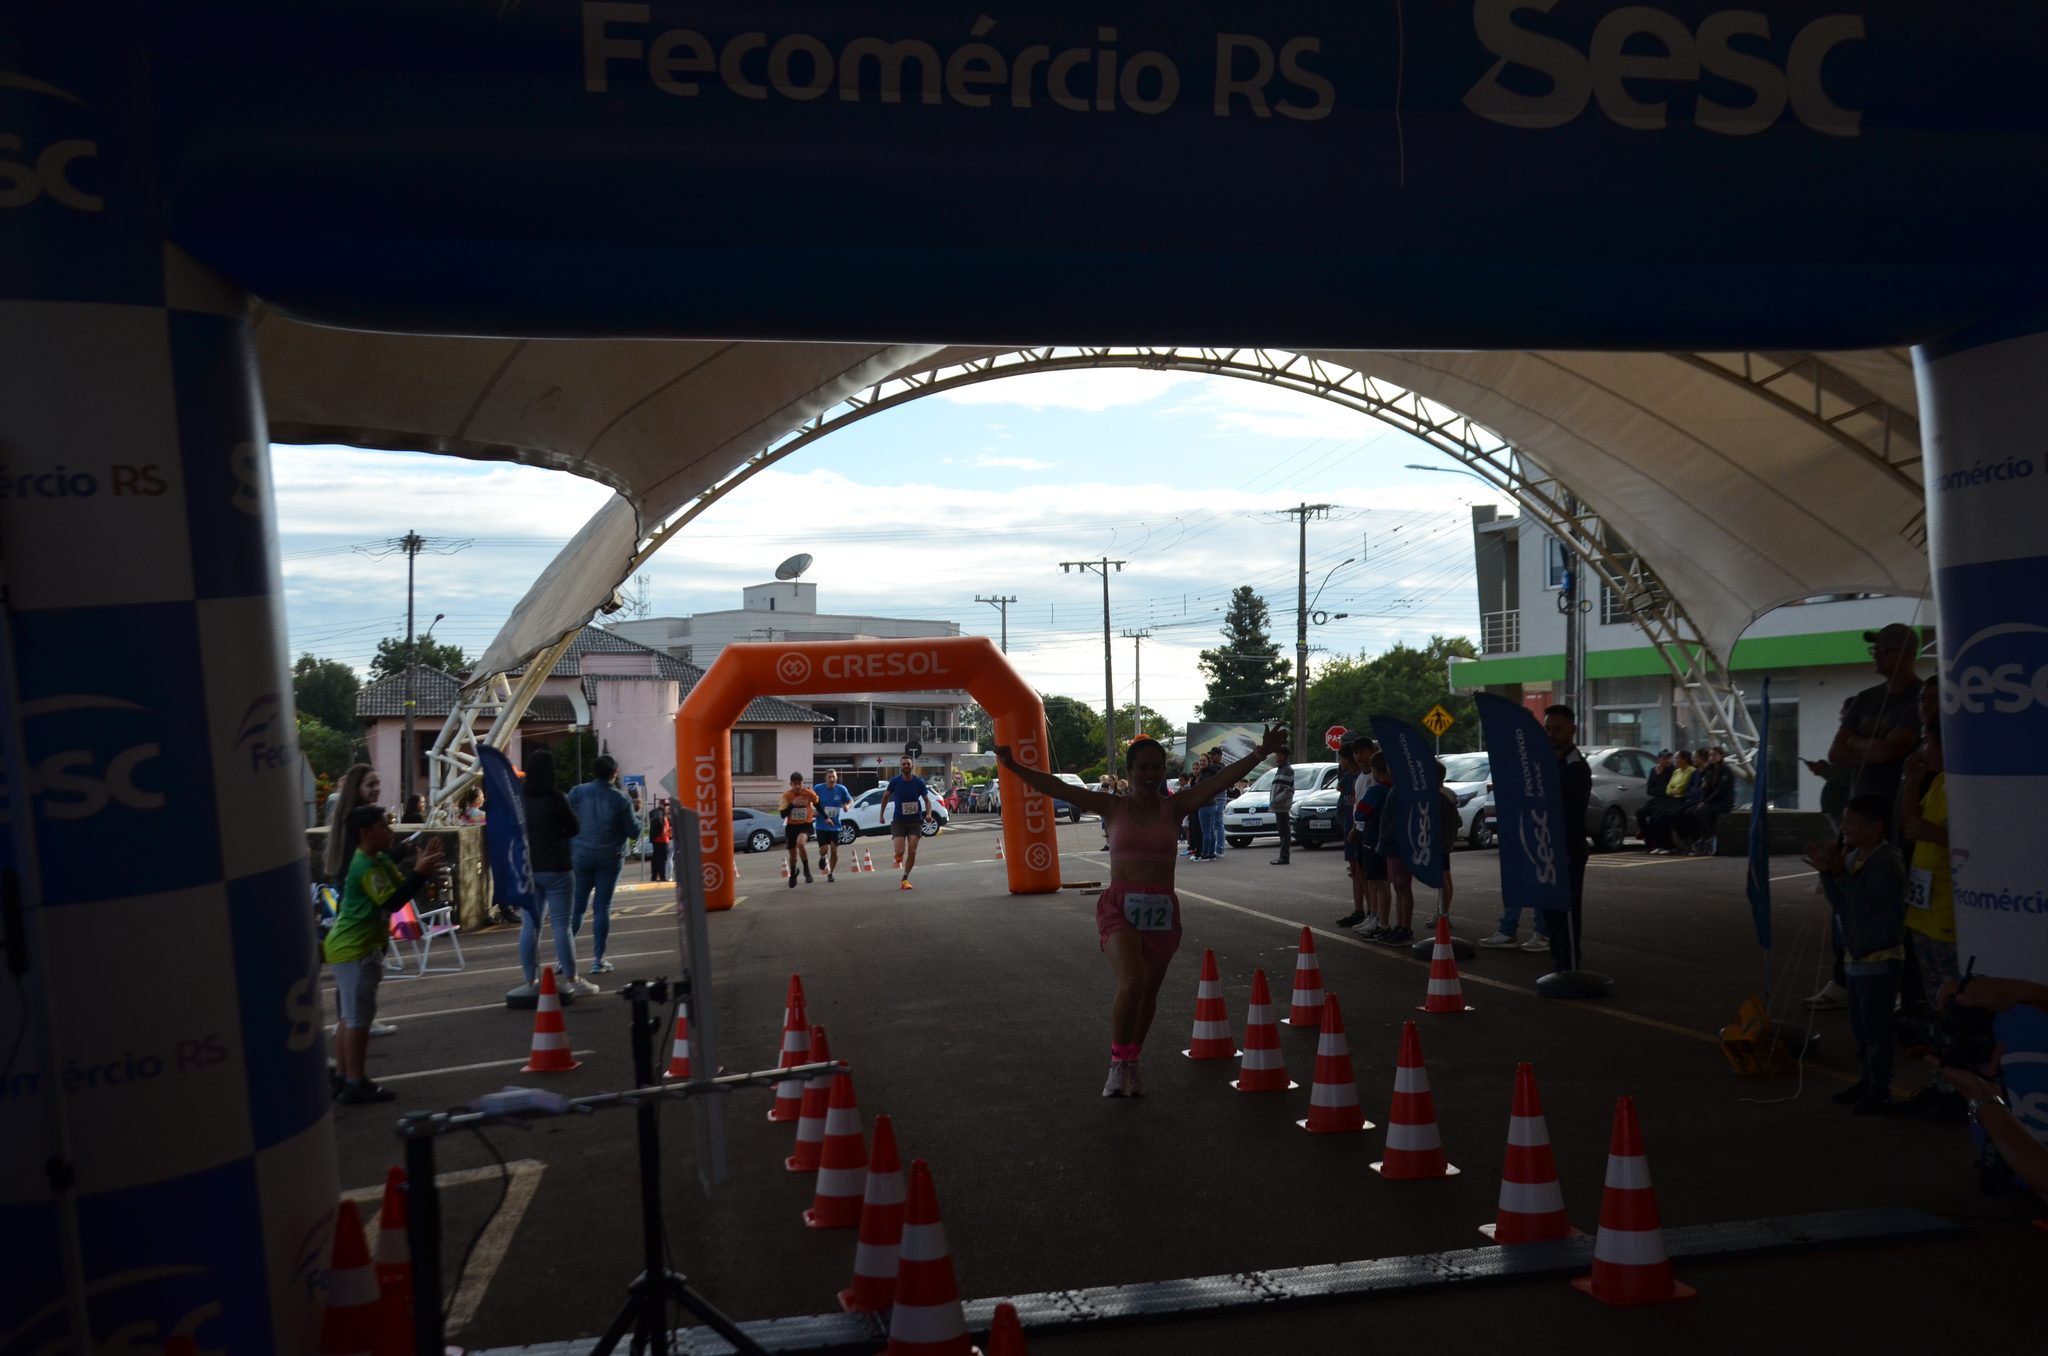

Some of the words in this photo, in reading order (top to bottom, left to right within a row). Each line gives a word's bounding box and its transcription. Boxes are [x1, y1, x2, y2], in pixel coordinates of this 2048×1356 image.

[581, 2, 1180, 115] Fecomércio
[1214, 32, 1336, 121] RS
[1460, 0, 1866, 137] Sesc
[111, 464, 168, 496] RS
[821, 650, 949, 679] CRESOL
[695, 746, 719, 854] CRESOL
[1018, 729, 1045, 834] CREOL
[1412, 801, 1431, 866] Sesc
[1531, 809, 1557, 886] Sesc
[1131, 907, 1167, 928] 112
[175, 1034, 228, 1072] RS
